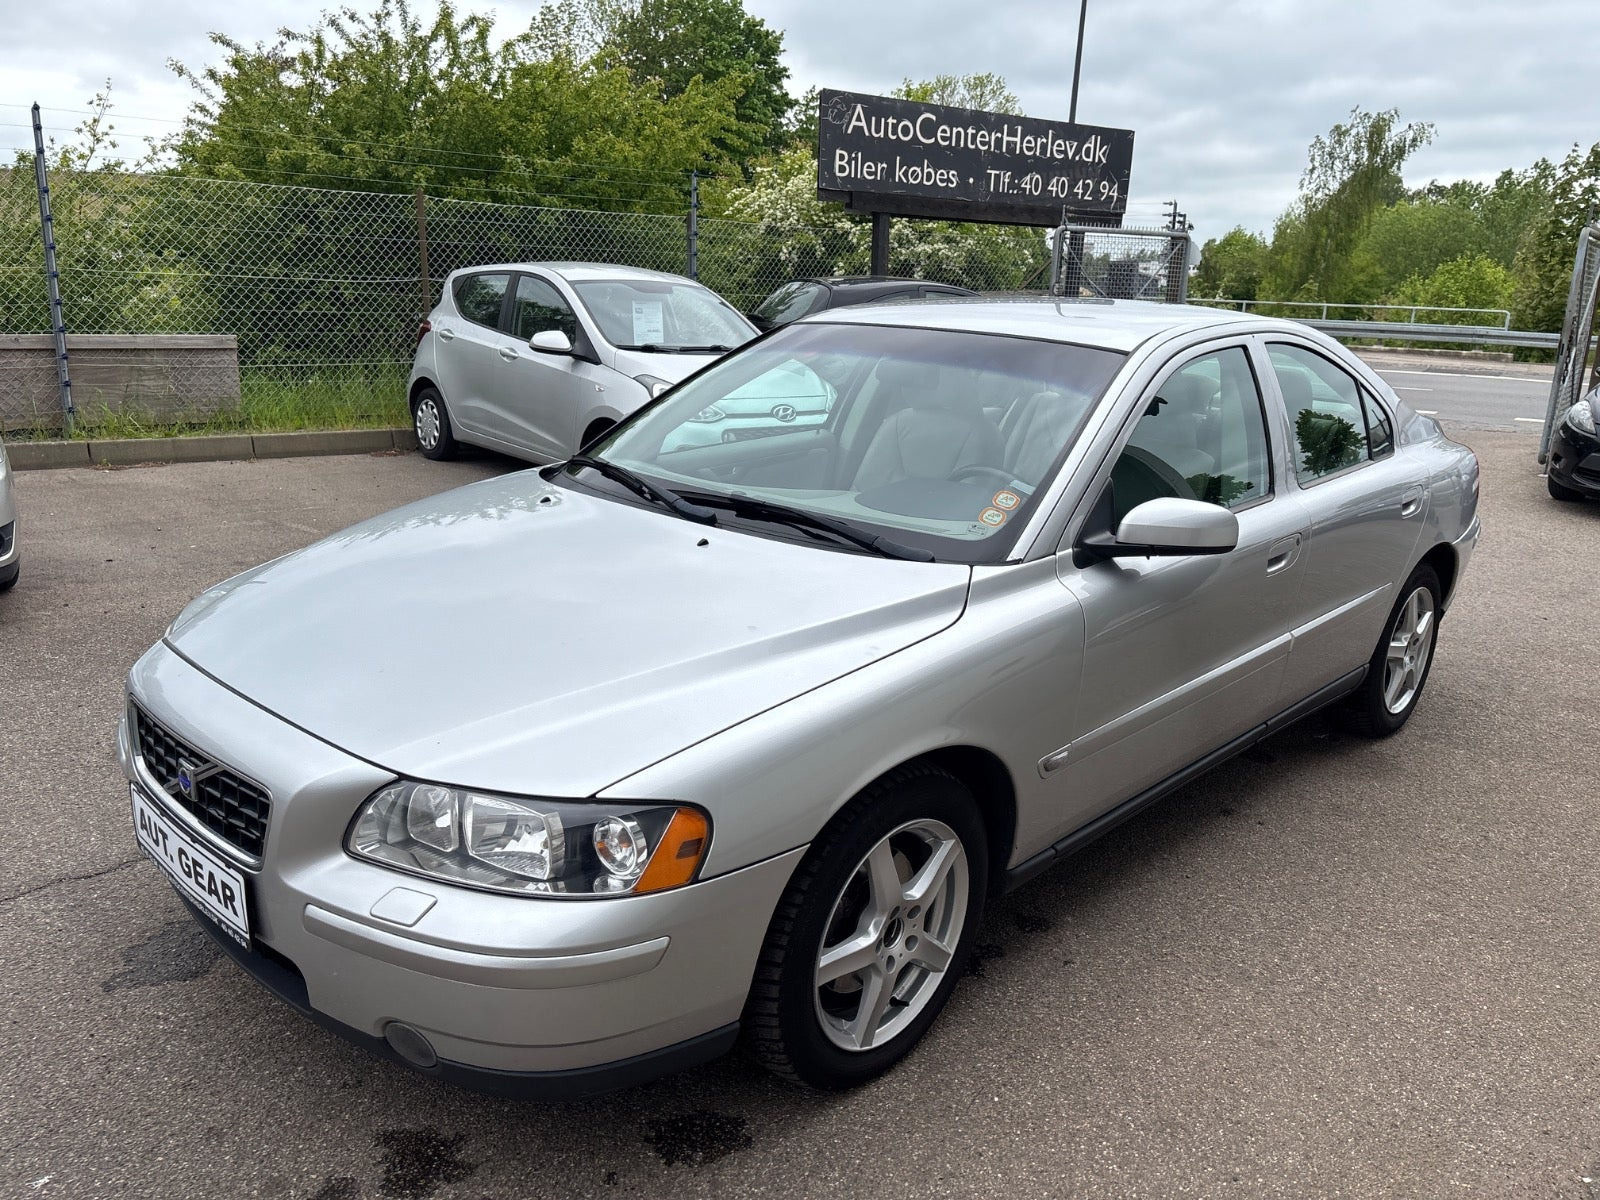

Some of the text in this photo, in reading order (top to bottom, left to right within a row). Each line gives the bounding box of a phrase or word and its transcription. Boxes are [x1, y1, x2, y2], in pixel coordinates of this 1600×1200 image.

[847, 104, 1107, 164] AutoCenterHerlev.dk
[835, 149, 887, 181] Biler
[895, 155, 958, 188] købes
[1047, 176, 1068, 198] 40
[1073, 179, 1093, 201] 42
[1099, 181, 1118, 204] 94
[140, 807, 174, 863] AUT.
[177, 846, 239, 919] GEAR
